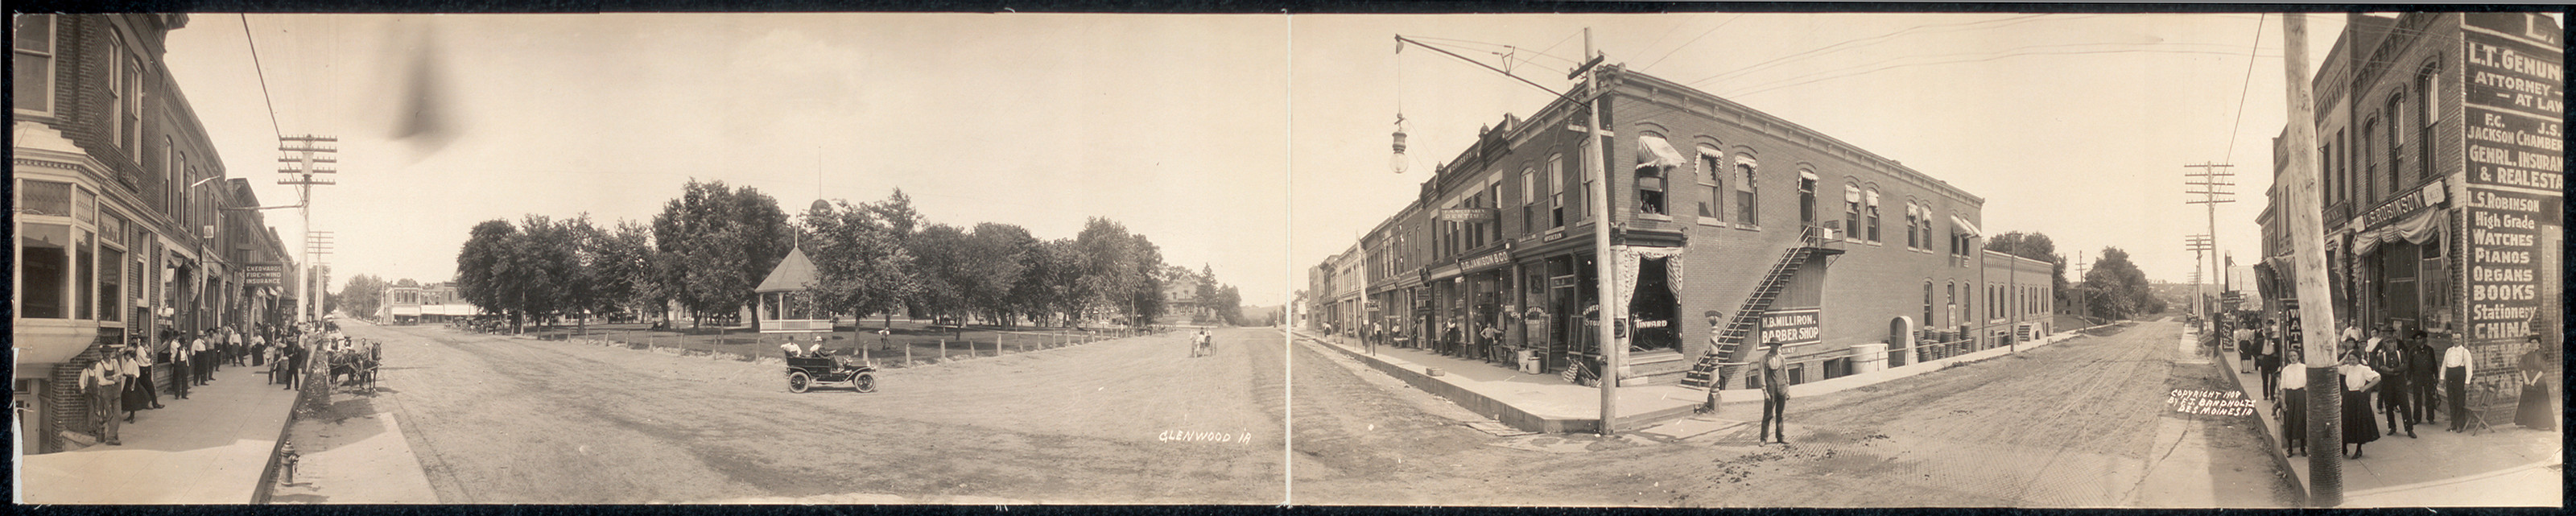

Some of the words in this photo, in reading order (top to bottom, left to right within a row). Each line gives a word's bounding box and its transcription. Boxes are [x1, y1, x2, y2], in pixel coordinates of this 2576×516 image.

[2502, 49, 2562, 81] GENUN
[2475, 71, 2551, 96] ATTORNEY
[2515, 93, 2533, 107] AT
[2485, 113, 2505, 128] F.C.
[2537, 122, 2561, 137] J.S.
[2467, 126, 2515, 144] JACKSON
[2469, 145, 2517, 167] GENRL.
[2480, 167, 2491, 182] &
[2475, 211, 2501, 229] High
[2504, 214, 2535, 229] Grade
[2473, 229, 2533, 246] WATCHES
[2475, 247, 2530, 263] PIANOS
[2474, 266, 2533, 282] ORGANS
[2473, 284, 2535, 300] BOOKS
[2473, 303, 2537, 323] Stationery
[1762, 328, 1798, 344] BARBER
[1798, 326, 1819, 340] SHOP
[2475, 320, 2533, 339] CHINA
